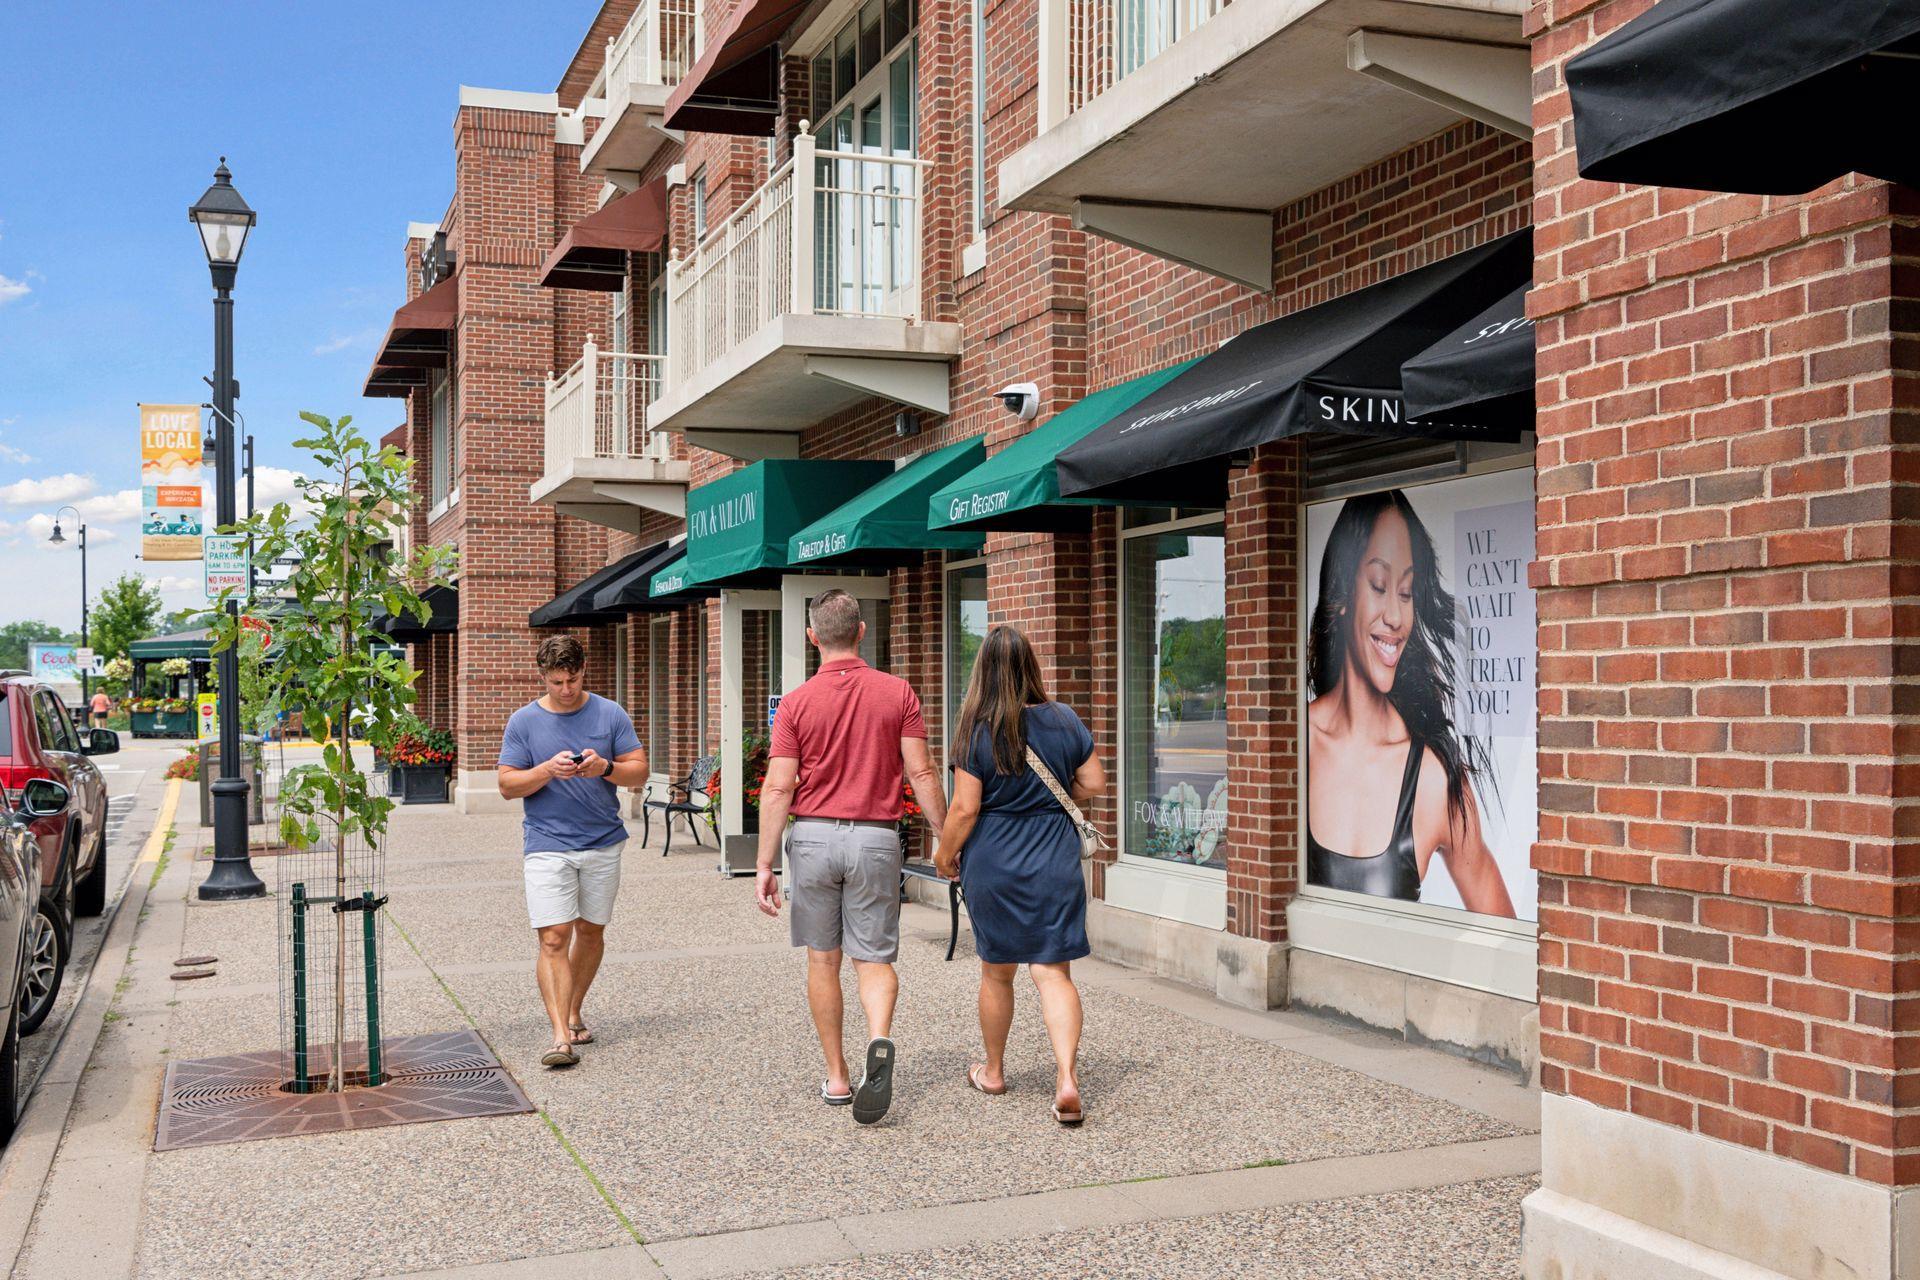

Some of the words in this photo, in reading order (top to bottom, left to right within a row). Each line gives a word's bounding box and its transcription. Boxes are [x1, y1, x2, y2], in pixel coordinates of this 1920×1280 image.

[1463, 316, 1536, 344] SKI
[1119, 380, 1264, 434] SKINSPIRIT
[150, 413, 193, 431] LOVE
[146, 431, 197, 449] LOCAL
[691, 510, 708, 540] FOX
[710, 504, 717, 534] &
[719, 489, 758, 531] WILLOW
[210, 541, 216, 550] 3
[219, 541, 242, 550] HOU
[824, 534, 831, 553] &
[1466, 529, 1497, 556] WE
[208, 575, 218, 584] NO
[219, 575, 246, 584] PARKING
[1467, 558, 1522, 588] CAN'T
[1467, 592, 1516, 619] WAIT
[1467, 626, 1491, 651] TO
[41, 651, 74, 665] Coo
[1467, 657, 1526, 684] TREAT
[1467, 690, 1511, 715] YOU!
[1134, 800, 1157, 825] FOX
[1160, 804, 1171, 827] &
